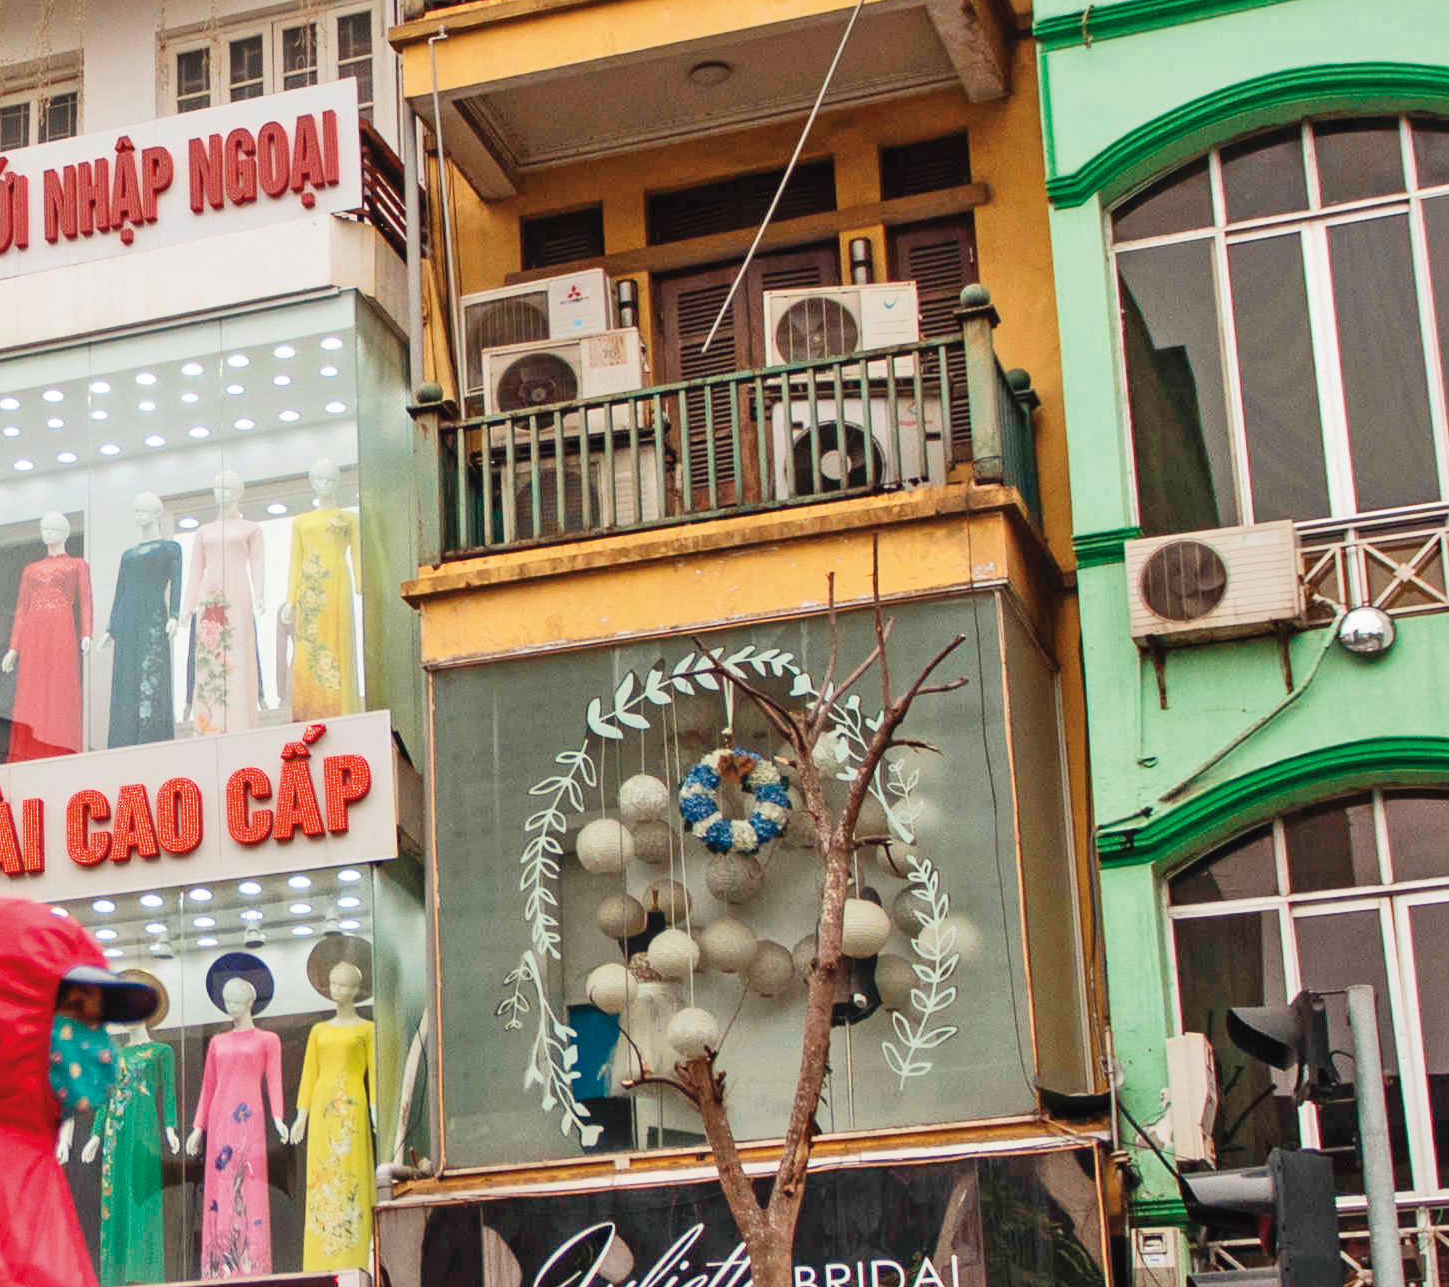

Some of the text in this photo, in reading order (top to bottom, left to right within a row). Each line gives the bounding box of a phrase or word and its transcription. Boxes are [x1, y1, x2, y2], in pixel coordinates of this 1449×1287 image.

[43, 135, 174, 246] NHẬP
[188, 108, 342, 210] NGOẠI
[66, 776, 204, 868] CAO
[227, 722, 374, 847] CẤP
